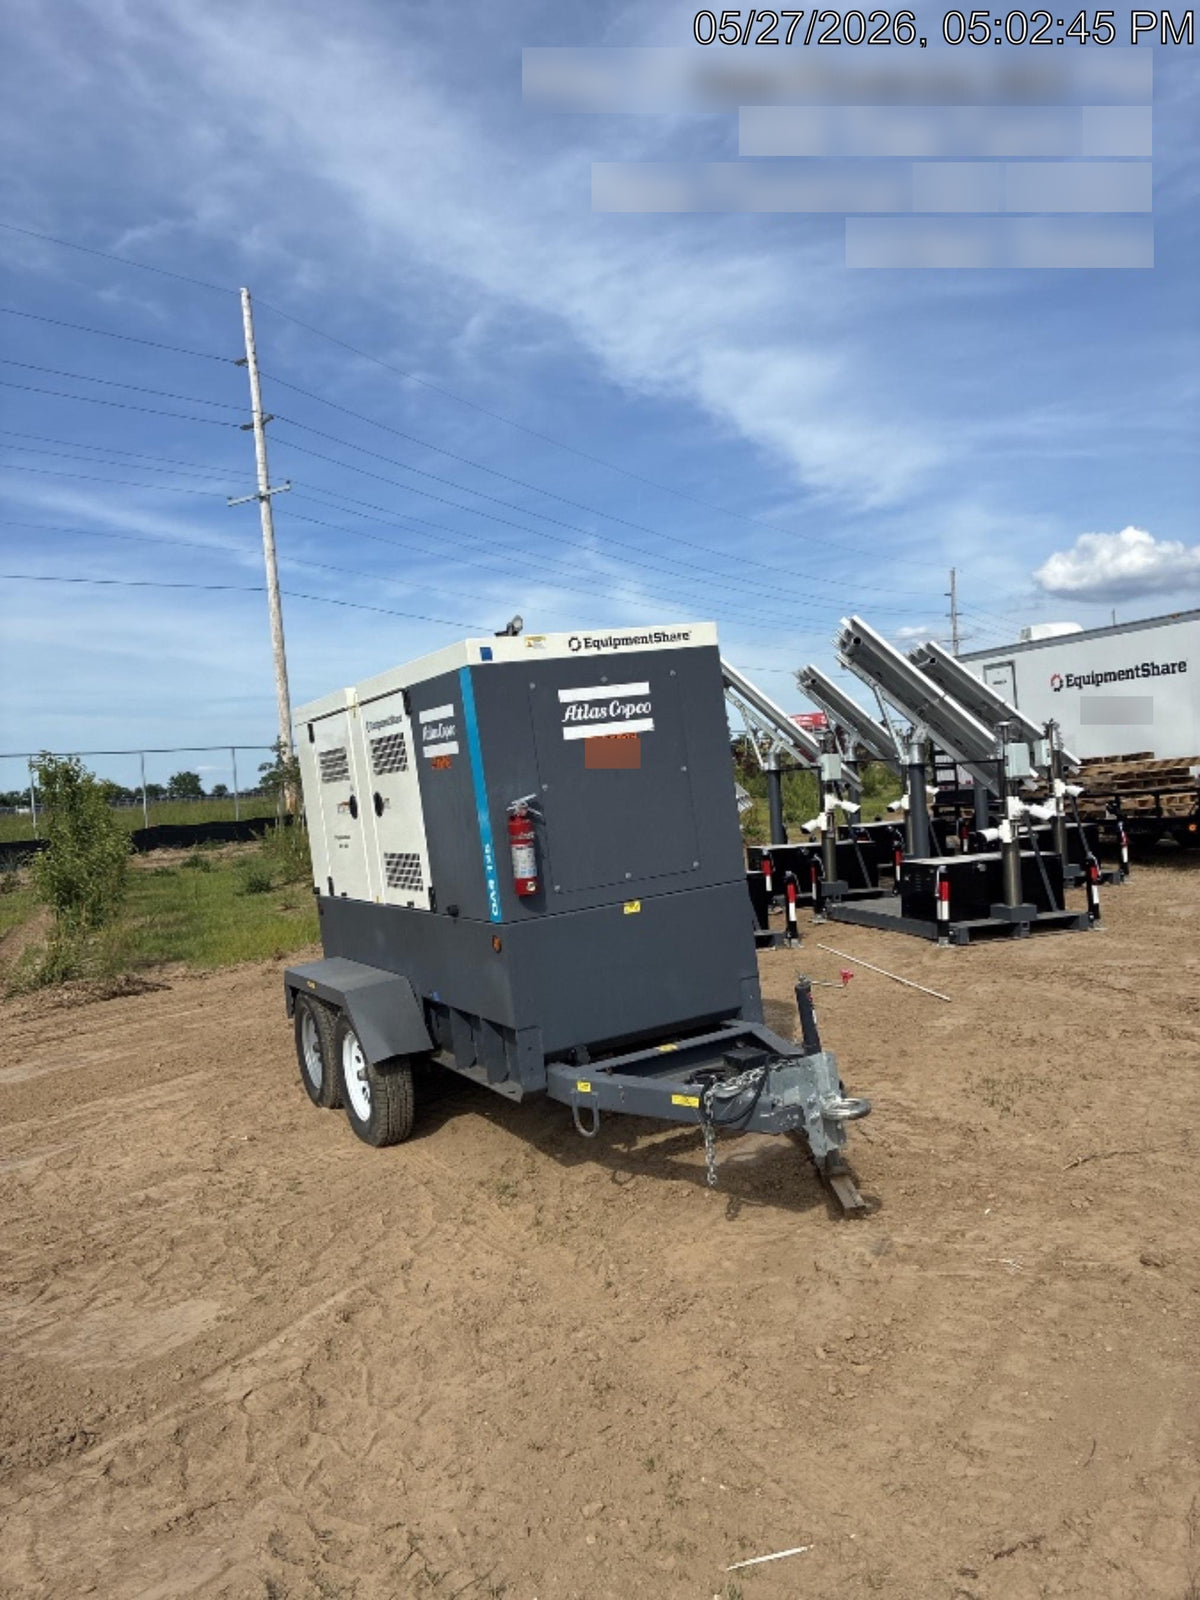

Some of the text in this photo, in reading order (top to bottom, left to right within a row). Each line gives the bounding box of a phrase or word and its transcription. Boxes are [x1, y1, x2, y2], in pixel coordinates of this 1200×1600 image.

[584, 631, 690, 651] EquipmentShare
[1065, 660, 1187, 690] EquipmentShare
[561, 700, 652, 722] Atlas Copco
